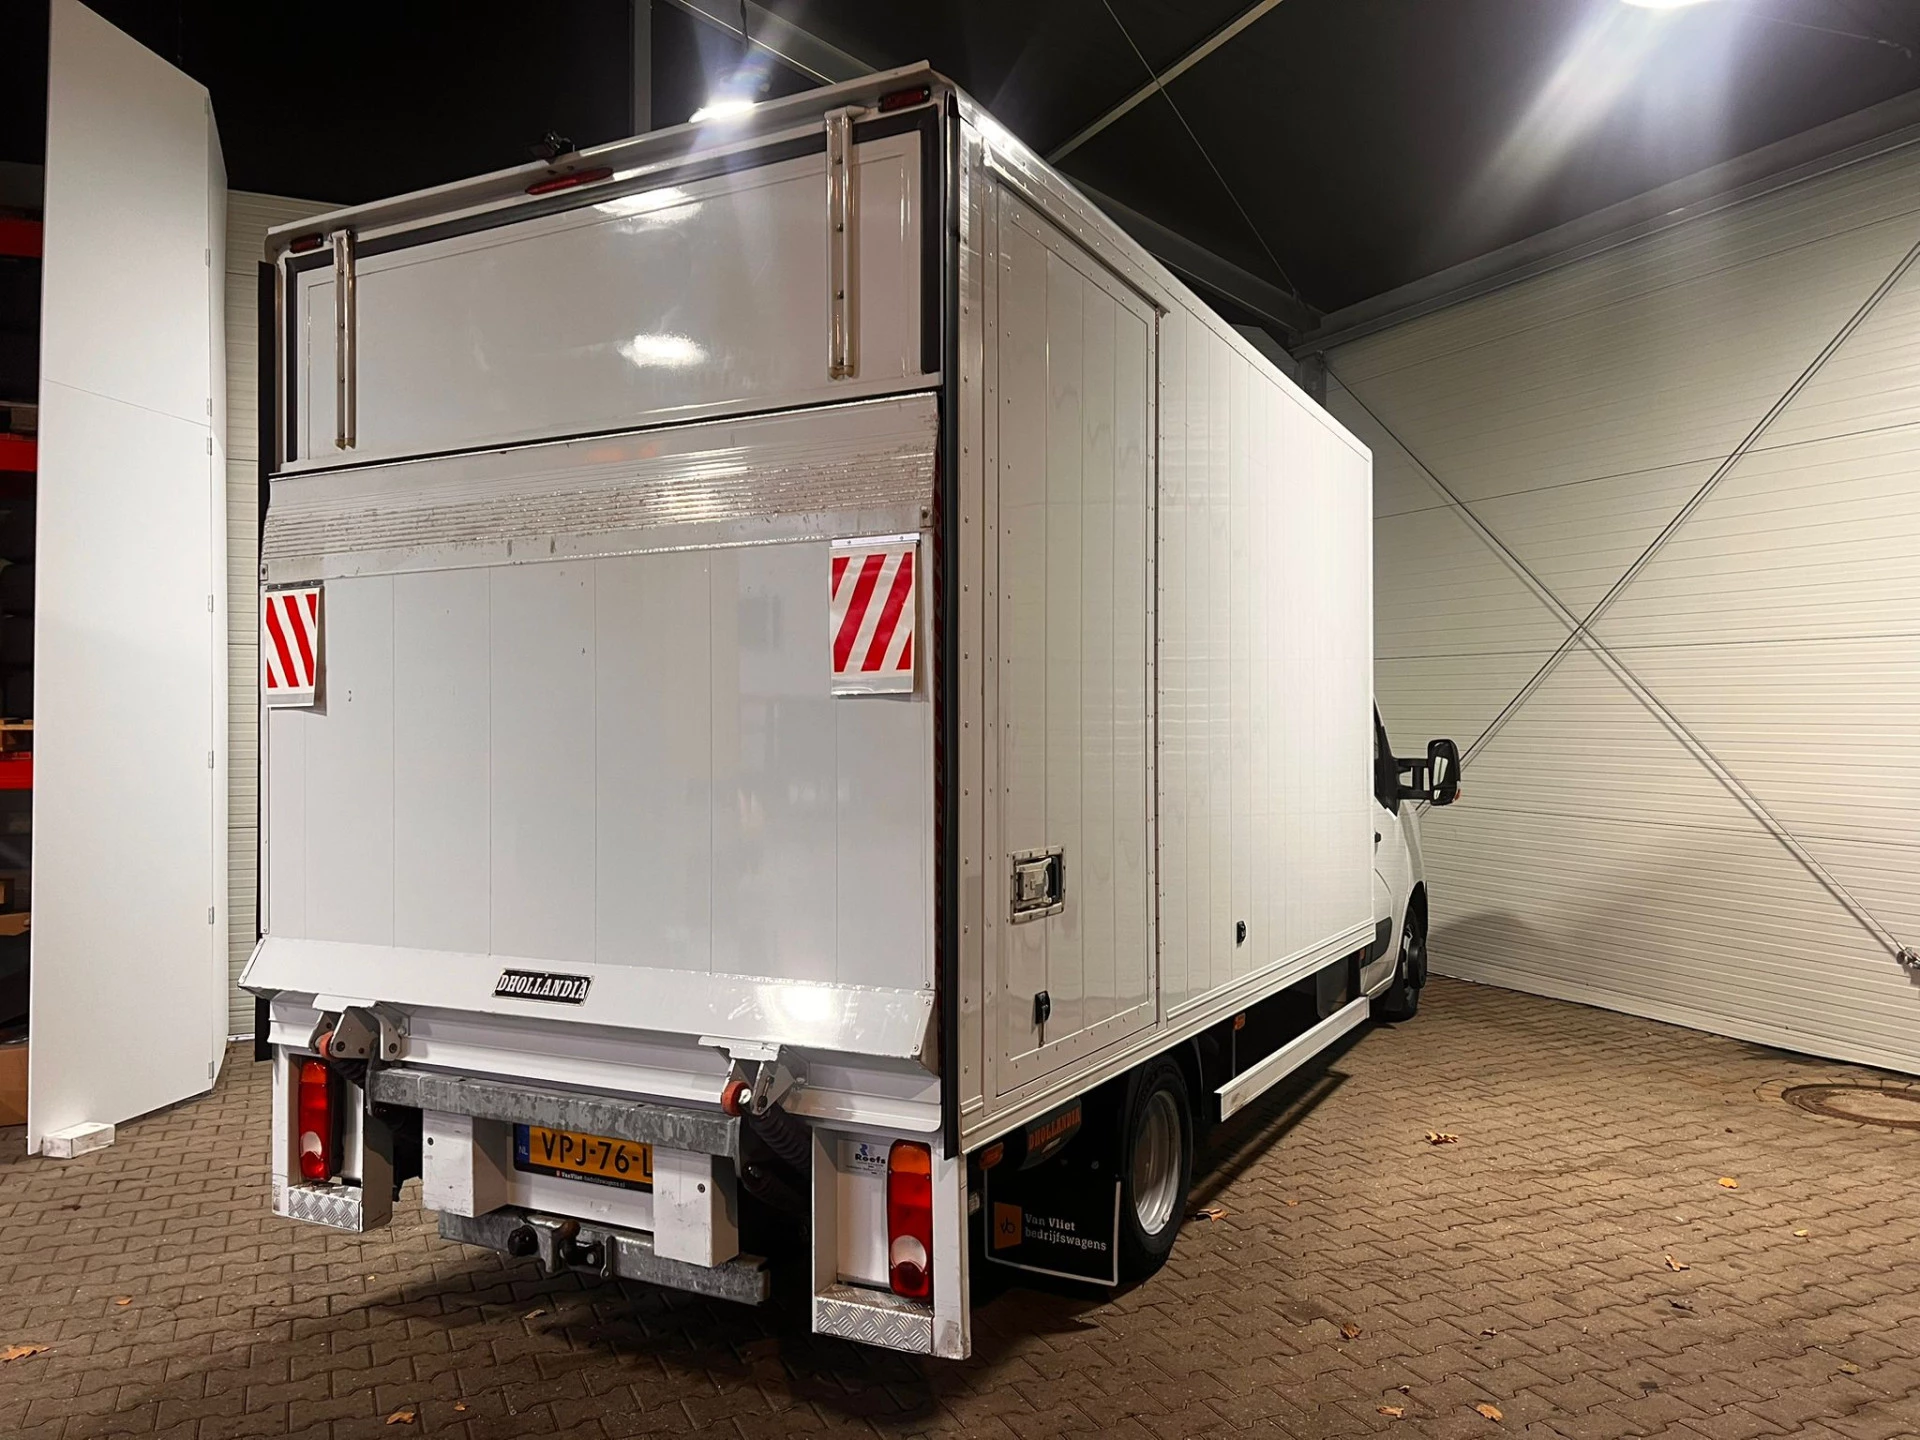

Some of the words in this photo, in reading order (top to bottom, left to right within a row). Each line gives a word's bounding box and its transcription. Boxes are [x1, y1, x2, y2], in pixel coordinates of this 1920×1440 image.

[496, 974, 588, 999] DHOLLANDIA
[1028, 1105, 1081, 1151] DHOLLANDIA
[518, 1145, 528, 1156] NL
[541, 1131, 653, 1178] VPJ-76-L
[1024, 1213, 1046, 1226] Van
[1049, 1217, 1076, 1232] Vliet
[1024, 1226, 1107, 1251] bedrijfswagens
